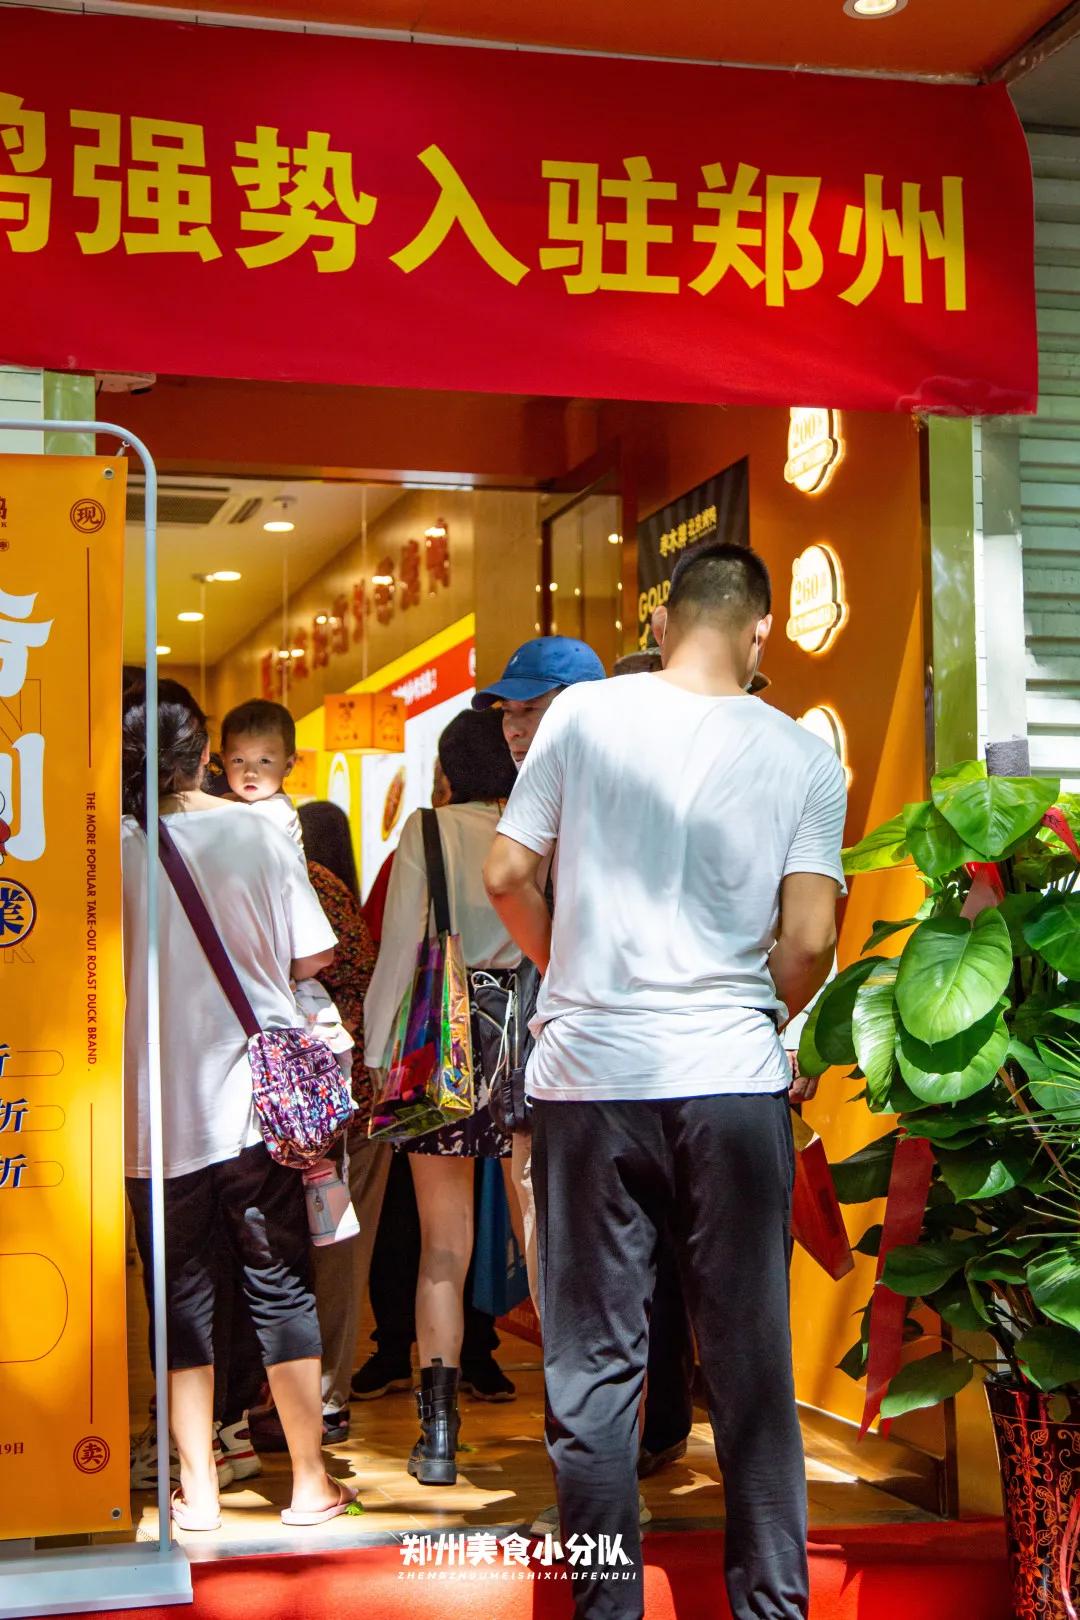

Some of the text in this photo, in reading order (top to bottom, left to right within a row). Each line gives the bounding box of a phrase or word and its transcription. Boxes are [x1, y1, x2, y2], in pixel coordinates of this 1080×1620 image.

[76, 507, 101, 525] 现
[639, 580, 671, 623] GOLD
[86, 792, 97, 1065] THE MORE POPULAR TAKE-OUT ROAST DUCK BRAND
[80, 1443, 103, 1465] 卖
